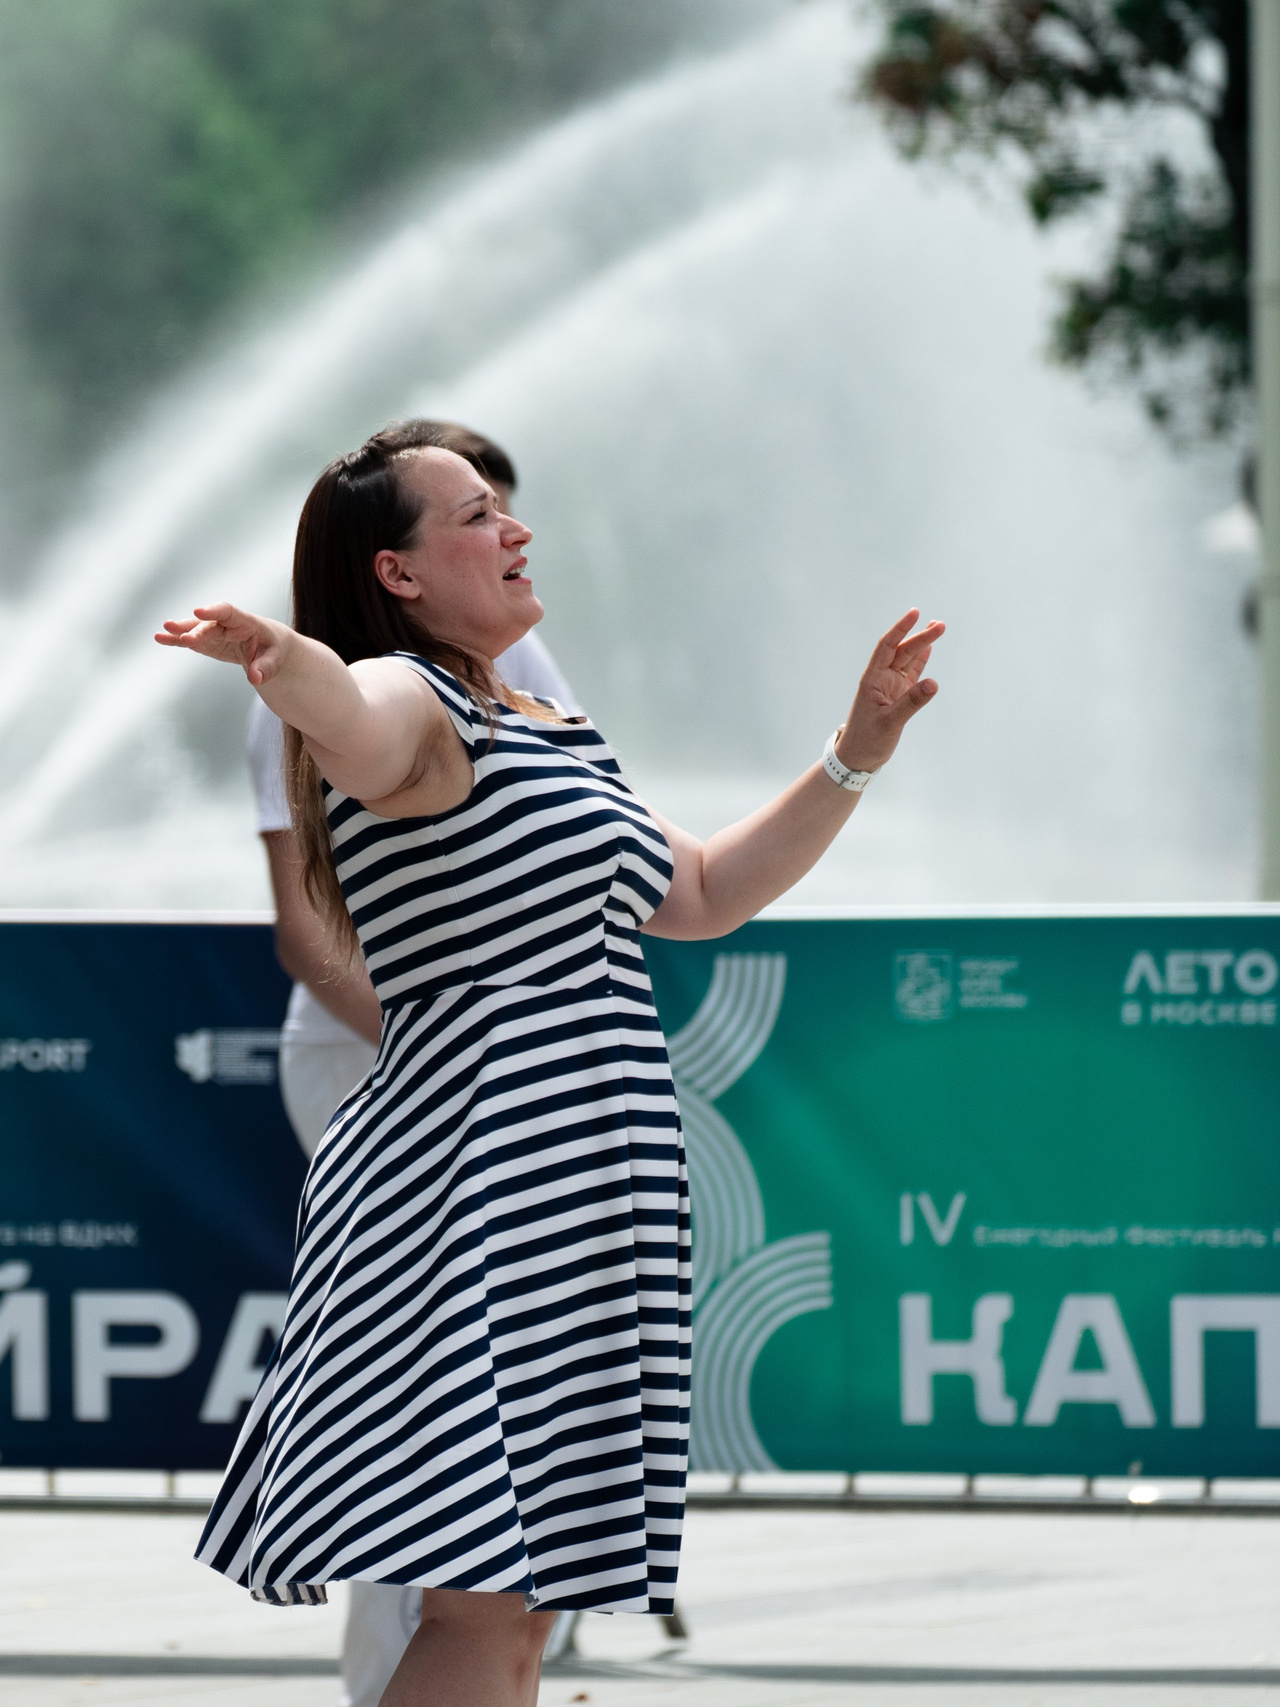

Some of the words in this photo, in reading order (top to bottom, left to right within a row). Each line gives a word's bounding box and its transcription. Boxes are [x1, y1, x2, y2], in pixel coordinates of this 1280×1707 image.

[1123, 950, 1278, 995] ЛЕТО
[1121, 1002, 1141, 1025] В
[1151, 1002, 1278, 1026] МОСКВЕ
[59, 1219, 136, 1248] ВДНХ
[900, 1192, 968, 1247] IV
